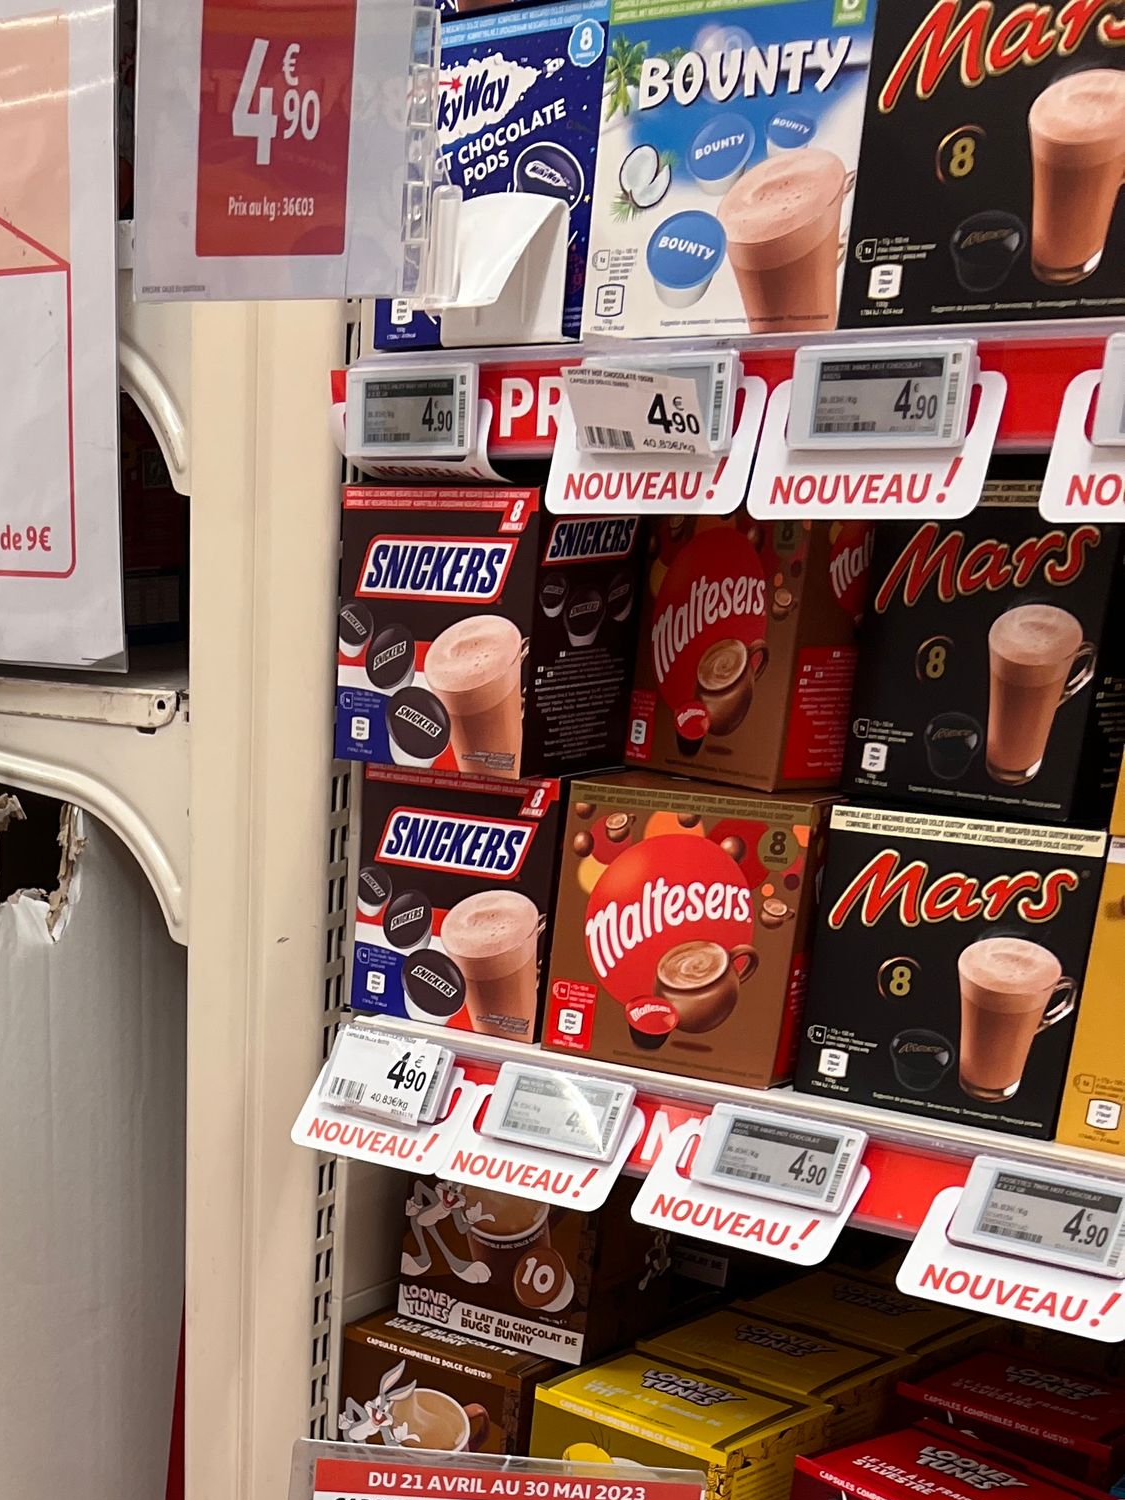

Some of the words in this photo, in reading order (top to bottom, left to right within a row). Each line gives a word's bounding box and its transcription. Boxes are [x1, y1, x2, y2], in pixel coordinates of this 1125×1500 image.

[637, 36, 852, 109] BOUNTY
[458, 98, 566, 164] CHOCOLATE
[771, 115, 810, 135] BOUNTY
[695, 132, 745, 160] BOUNTY
[949, 137, 975, 178] 8
[463, 150, 509, 186] PODS
[228, 196, 247, 215] Prix
[249, 202, 262, 216] au
[263, 197, 275, 221] kg
[282, 197, 314, 216] 36€03
[658, 235, 715, 261] BOUNTY
[0, 525, 22, 551] de
[26, 526, 52, 552] 9€
[549, 519, 637, 559] SNICKERS
[365, 543, 508, 595] SNICKERS
[876, 522, 1101, 614] Mars
[651, 575, 766, 684] Maltesers
[927, 645, 947, 678] 8
[395, 704, 442, 738] SNICKERS
[385, 815, 526, 872] SNICKERS
[828, 848, 1078, 930] Mars
[585, 875, 751, 978] Maltesers
[411, 965, 457, 998] SNICKERS
[889, 966, 912, 996] 8
[524, 1256, 556, 1294] 10
[403, 1285, 457, 1308] LOONEY
[407, 1300, 450, 1323] TUNES
[461, 1319, 490, 1334] BUGS
[494, 1326, 534, 1346] BUNNY
[462, 1308, 472, 1317] LE
[475, 1311, 494, 1324] LAIT
[497, 1318, 510, 1329] AU
[512, 1322, 562, 1343] CHOCOLAT
[565, 1336, 577, 1346] DE
[368, 1471, 397, 1488] DU
[401, 1474, 423, 1490] 21
[427, 1476, 486, 1495] AVRIL
[490, 1479, 520, 1495] AU
[524, 1481, 549, 1497] 30
[553, 1483, 591, 1500] MAI
[819, 1471, 855, 1492] CAPSULES
